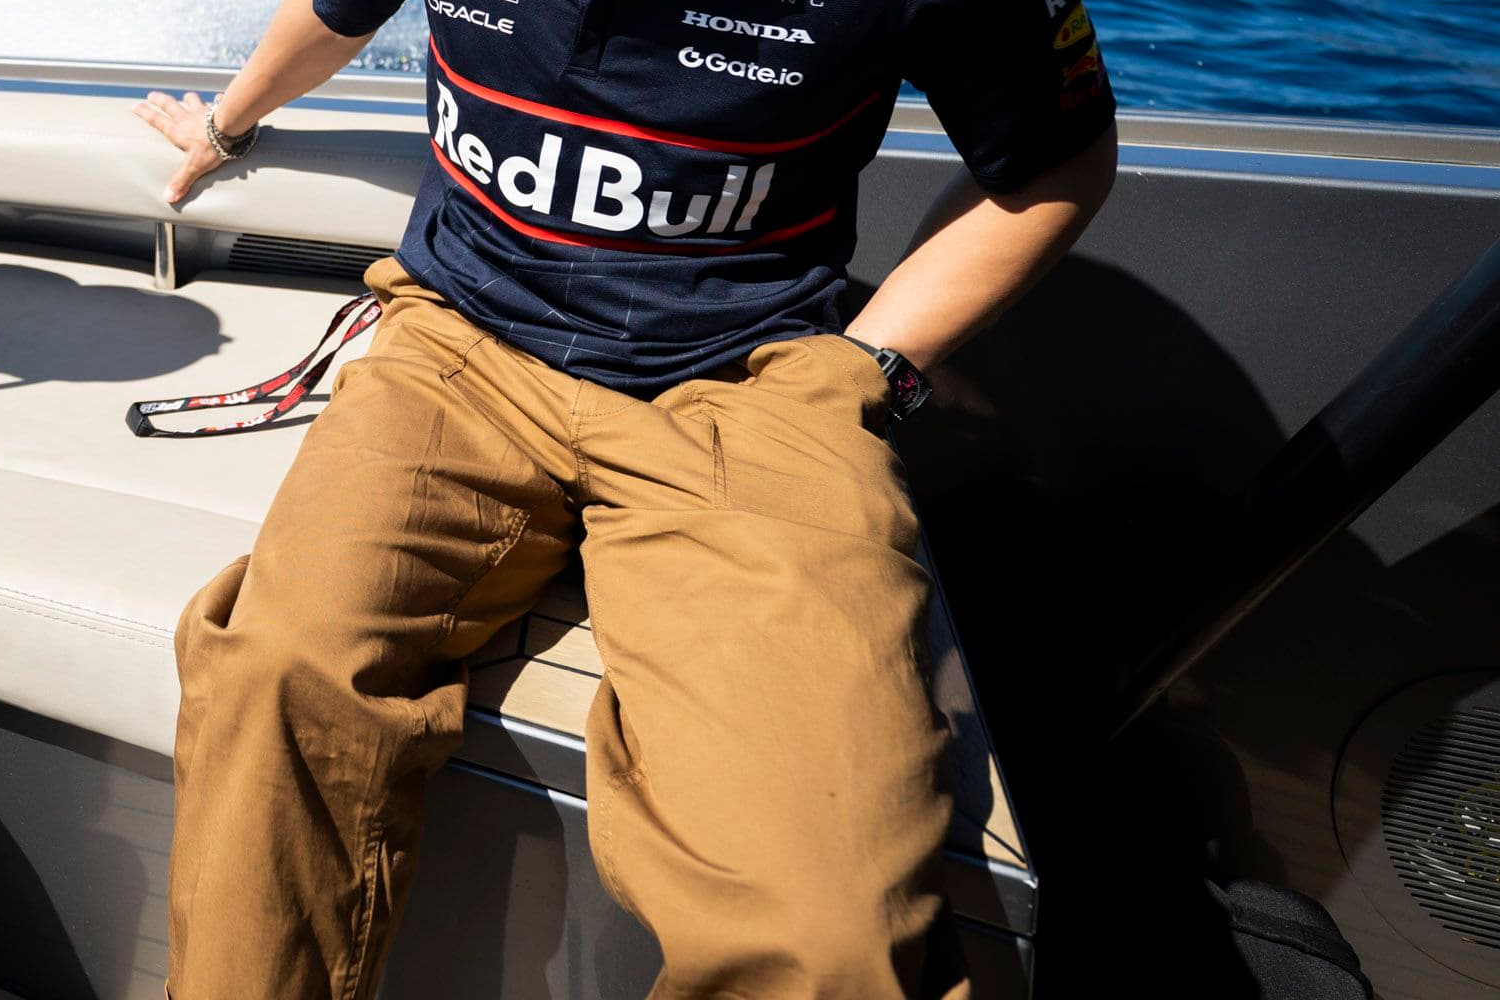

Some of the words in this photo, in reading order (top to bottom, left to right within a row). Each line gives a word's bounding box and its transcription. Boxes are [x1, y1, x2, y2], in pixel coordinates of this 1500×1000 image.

[681, 9, 816, 45] HONDA
[705, 52, 805, 87] Gate.io
[435, 78, 563, 216] Red
[571, 144, 776, 238] Bull
